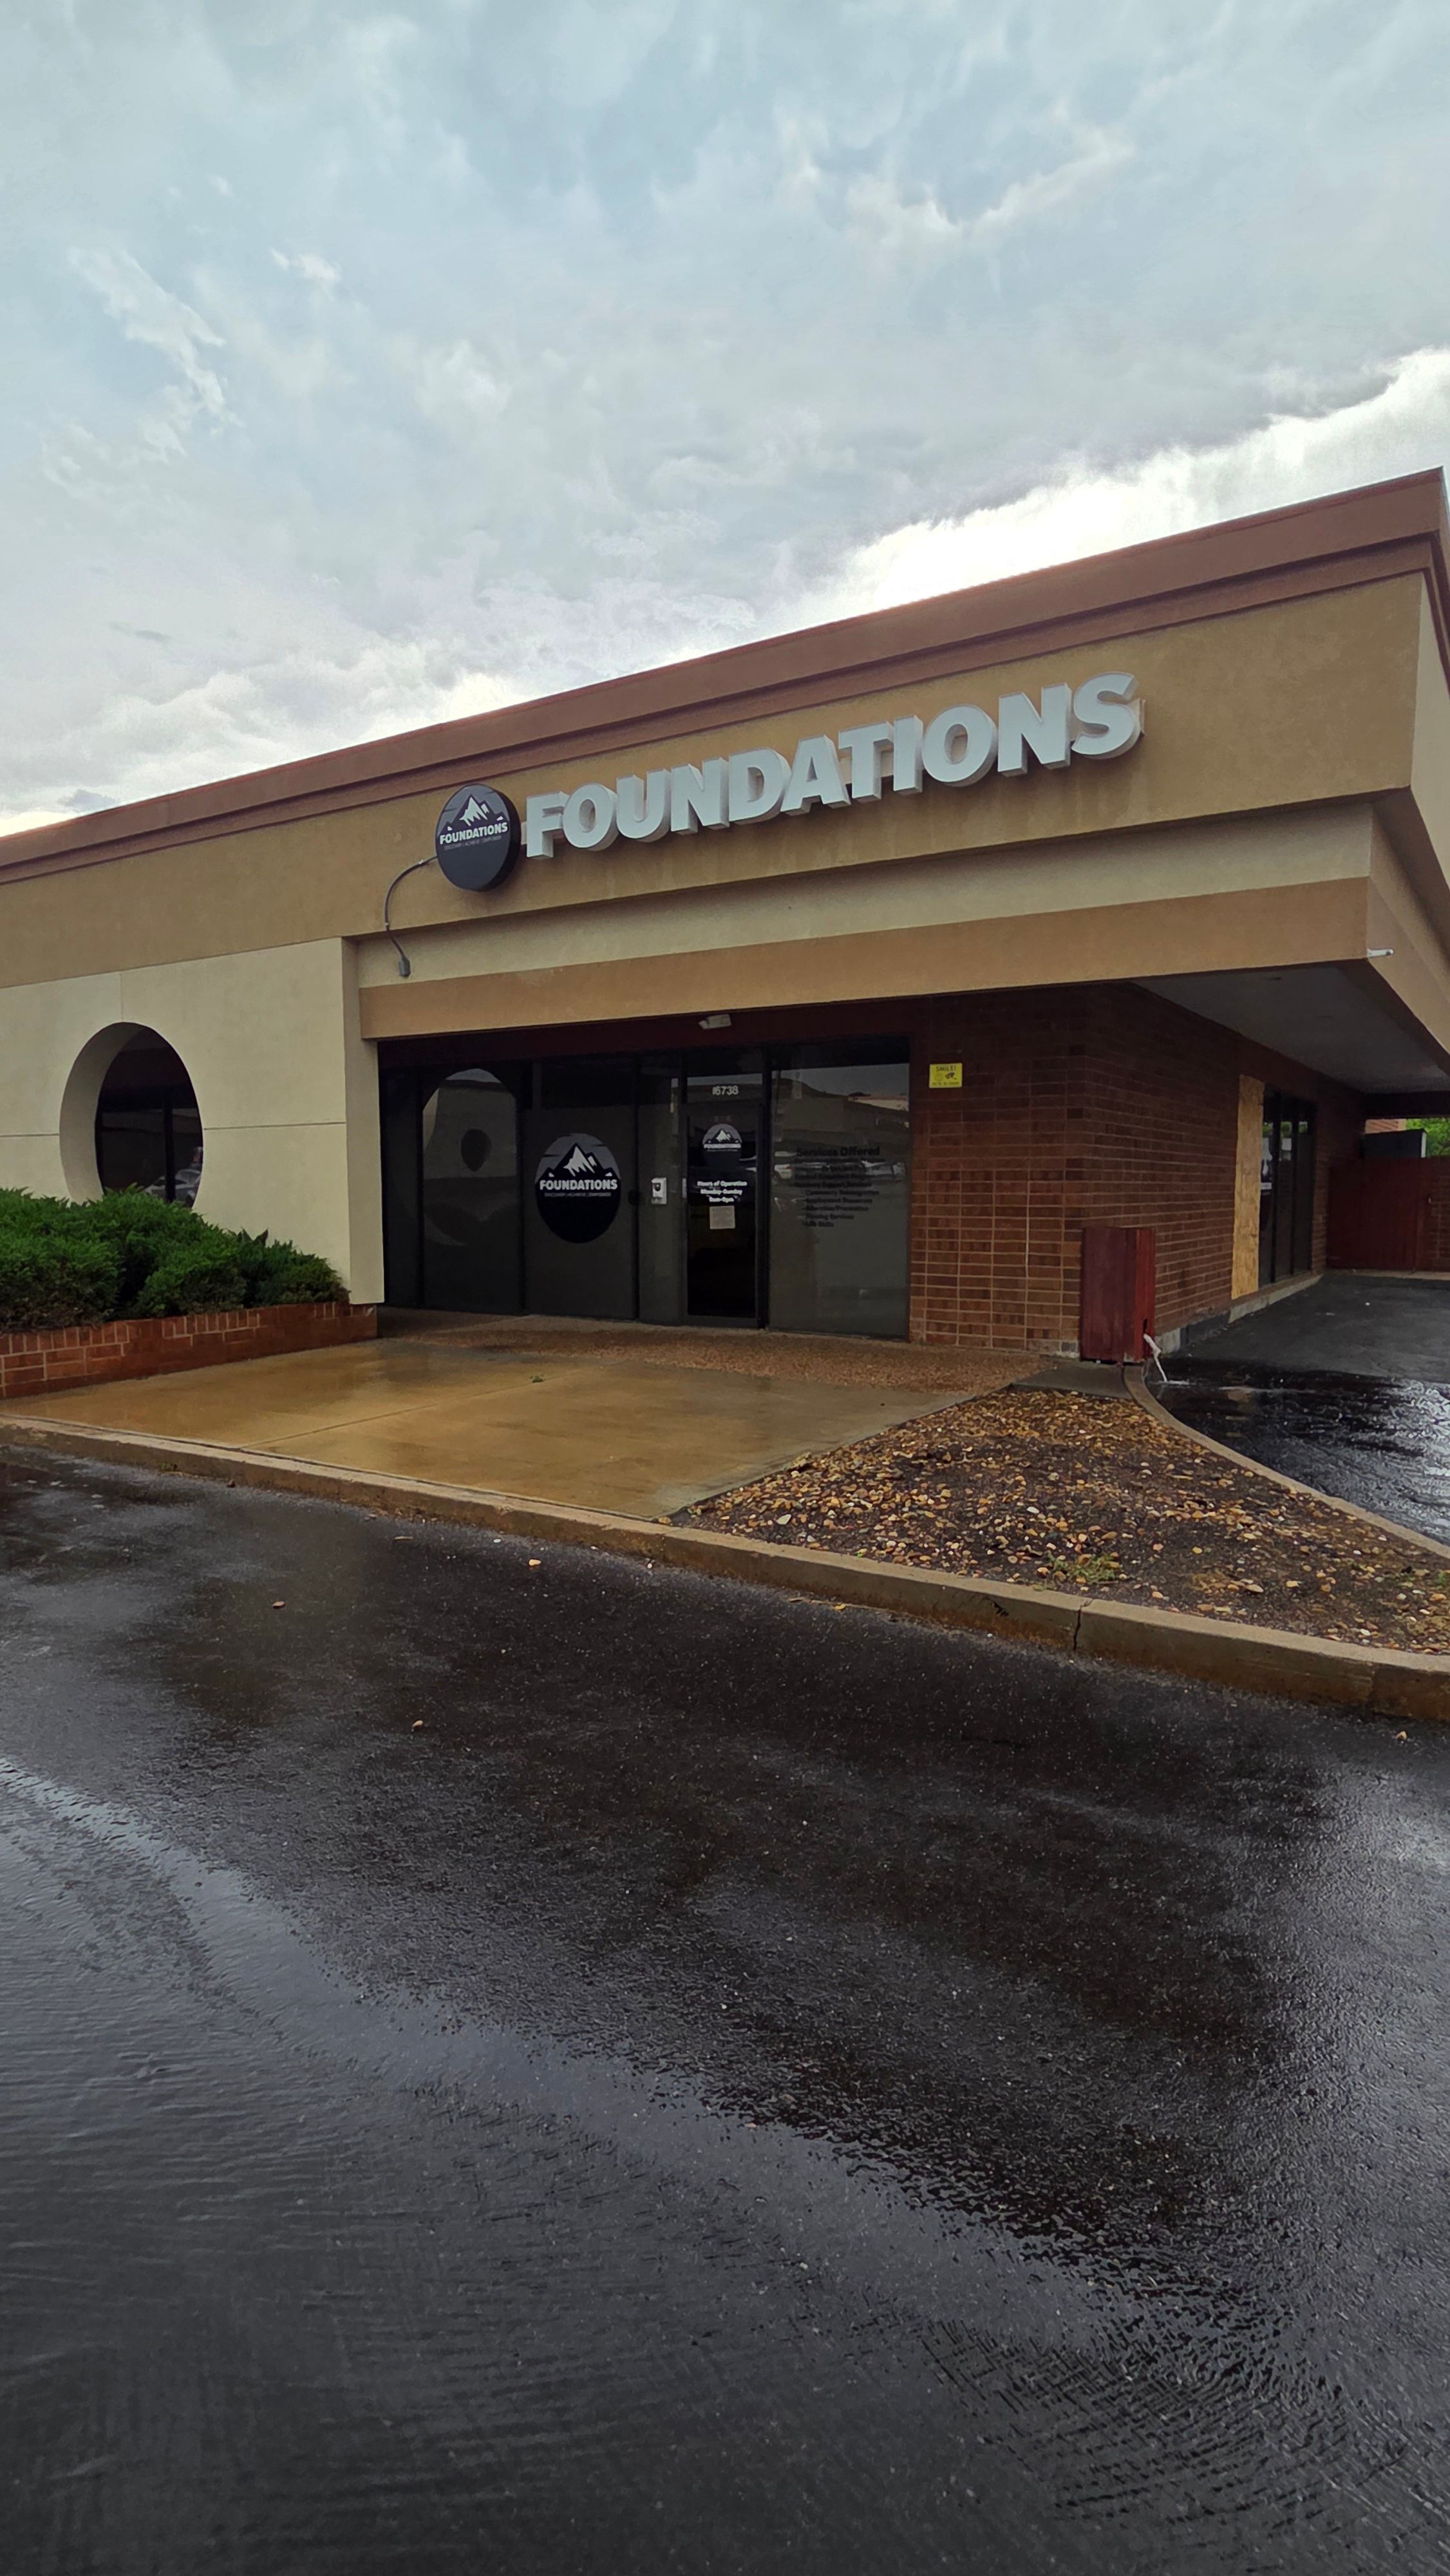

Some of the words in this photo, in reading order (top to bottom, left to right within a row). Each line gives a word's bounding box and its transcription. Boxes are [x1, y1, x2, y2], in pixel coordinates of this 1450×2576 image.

[526, 671, 1144, 858] FOUNDATIONS
[439, 822, 508, 845] FOUNDATIONS
[712, 1084, 739, 1095] 16738
[796, 1148, 838, 1157] Services
[840, 1146, 880, 1157] Offered
[540, 1179, 618, 1190] FOUNDATIONS
